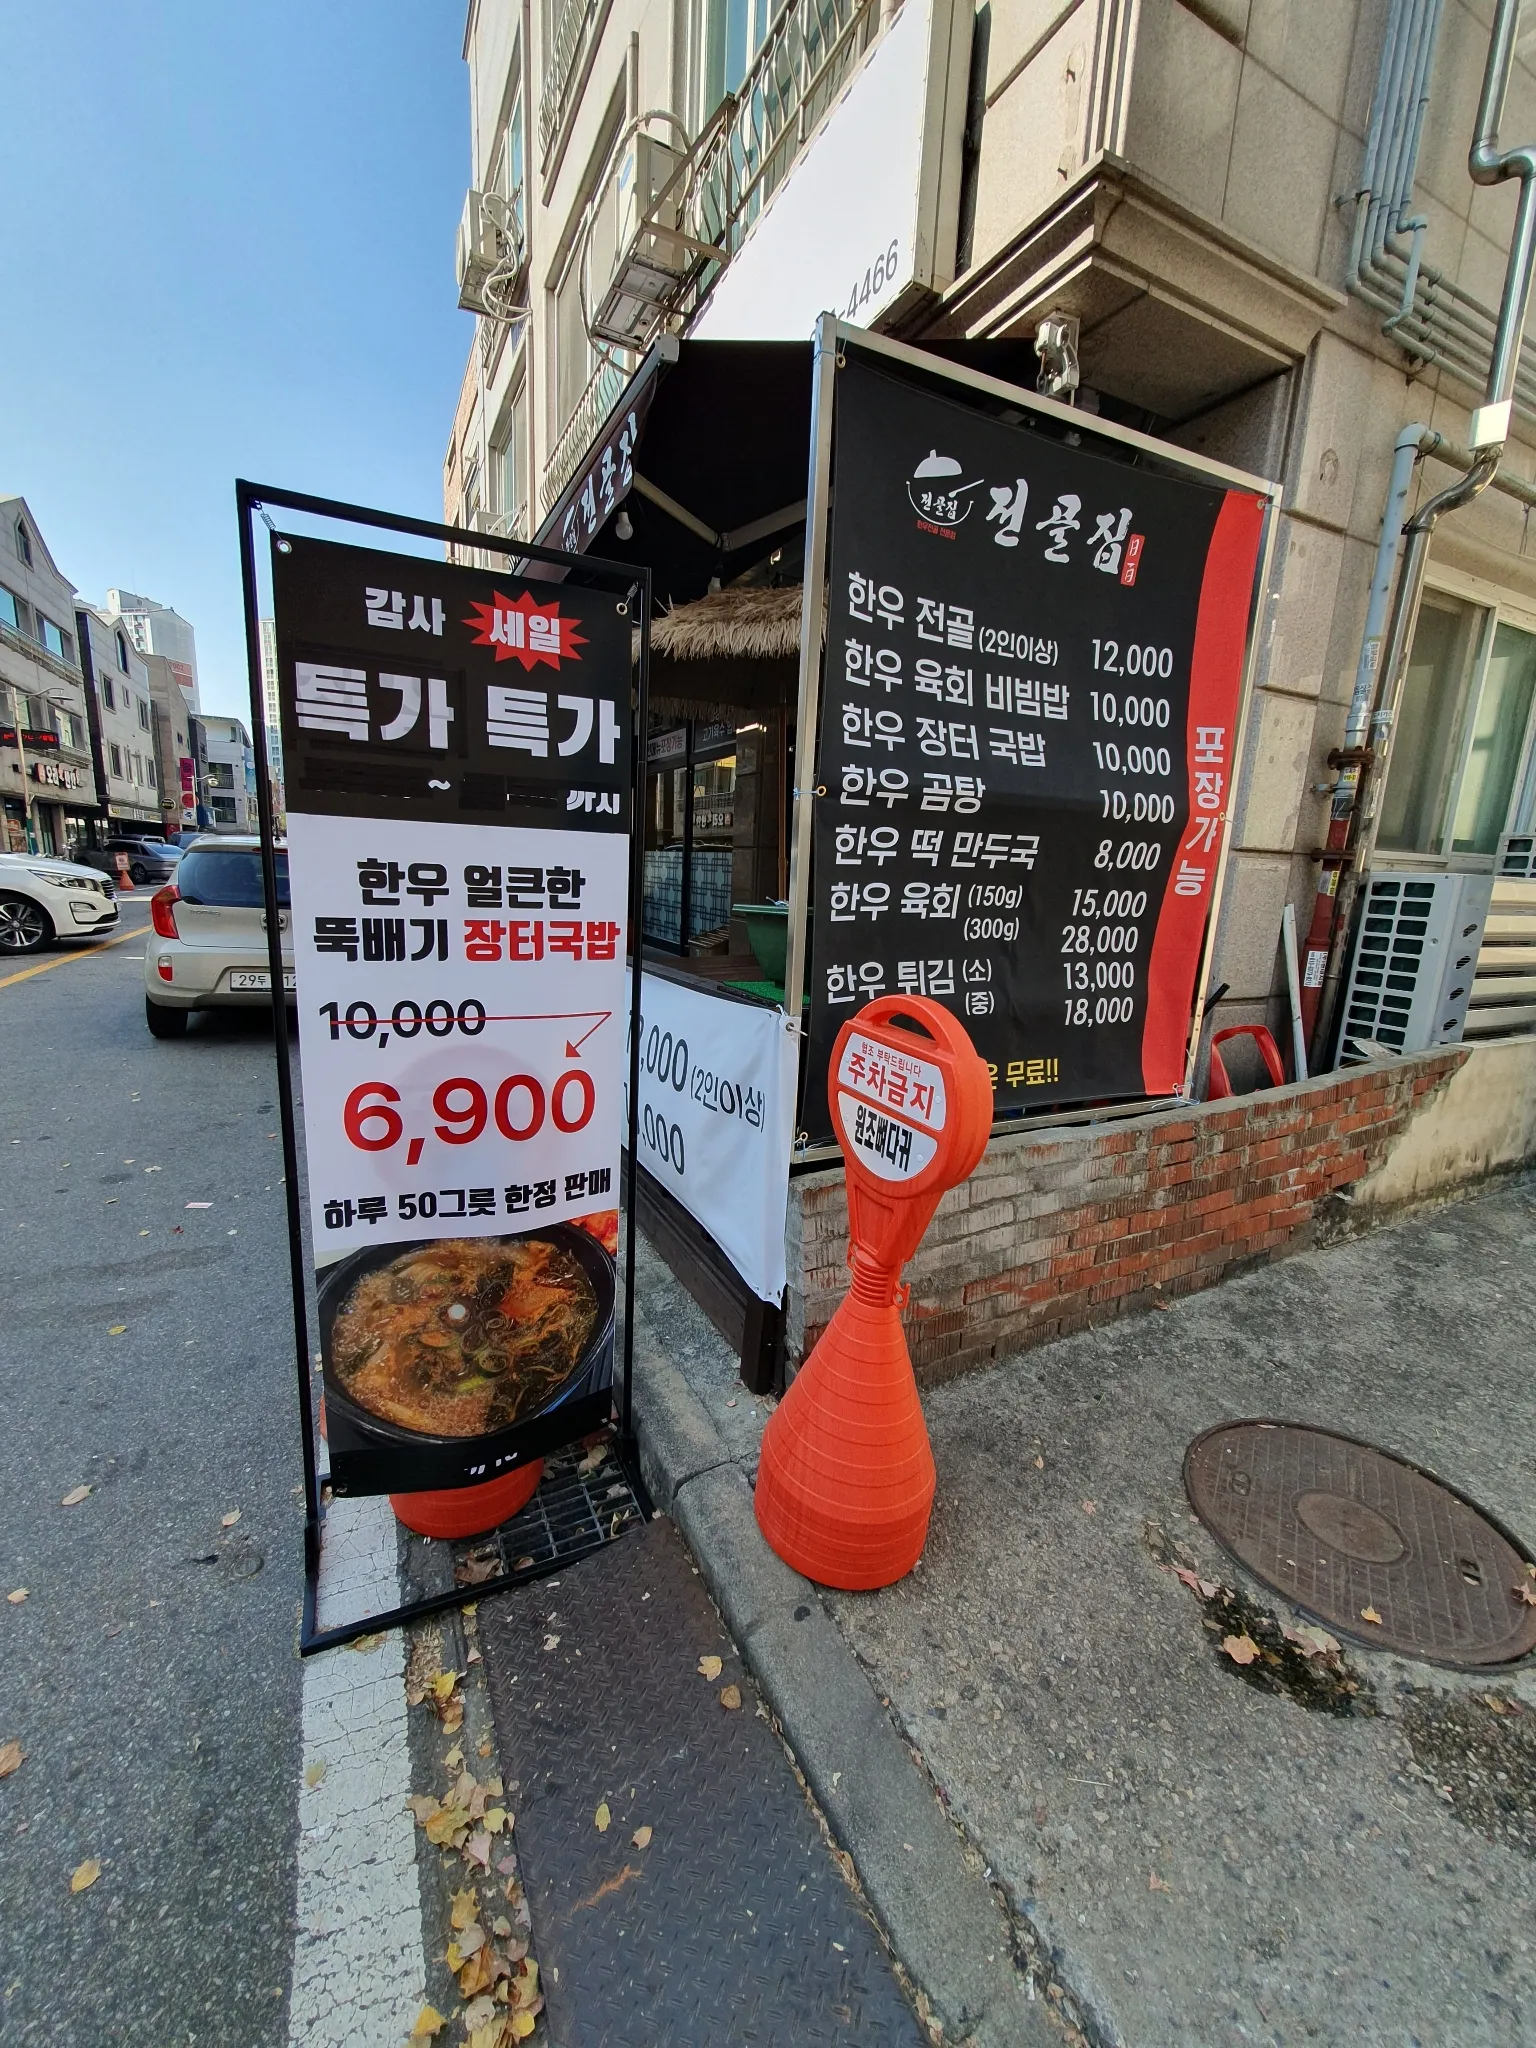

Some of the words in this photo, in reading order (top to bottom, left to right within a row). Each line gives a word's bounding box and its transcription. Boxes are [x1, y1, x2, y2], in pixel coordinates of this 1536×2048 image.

[832, 238, 899, 319] -4466
[921, 491, 958, 520] 전골집
[986, 478, 1132, 575] 전골집
[365, 587, 446, 635] 감사
[489, 609, 561, 654] 세일
[848, 571, 905, 630] 한우
[916, 597, 975, 651] 전골
[978, 626, 1059, 666] (2인이상)
[1092, 639, 1173, 678] 12,000
[845, 638, 903, 692] 한우
[915, 658, 974, 706] 육회
[985, 672, 1070, 720] 비빔밥
[1090, 691, 1170, 728] 10,000
[295, 662, 454, 749] 특가
[486, 685, 621, 764] 특가
[842, 702, 906, 752] 한우
[916, 717, 980, 761] 장터
[988, 727, 1046, 768] 국밥
[1093, 741, 1171, 777] 10,000
[840, 763, 909, 809] 한우
[920, 773, 986, 814] 곰탕
[1100, 790, 1175, 824] 10,000
[1174, 726, 1225, 897] 포장가능
[835, 824, 899, 866] 한우
[910, 829, 943, 866] 떡
[950, 831, 1039, 870] 만두국
[1094, 840, 1161, 871] 8,000
[357, 858, 450, 906] 한우
[463, 865, 586, 910] 얼큰한
[830, 881, 890, 922] 한우
[900, 882, 961, 920] 육회
[967, 884, 1023, 909] (150g)
[1072, 888, 1147, 917] 15,000
[314, 917, 449, 962] 뚝배기
[463, 919, 620, 962] 장터국밥
[964, 917, 1020, 942] (300g)
[1061, 925, 1138, 954] 28,000
[239, 974, 267, 987] 29두
[826, 961, 885, 1004] 한우
[897, 958, 956, 996] 튀김
[962, 958, 992, 984] (소)
[1063, 962, 1134, 991] 13,000
[319, 999, 486, 1048] 10,000
[965, 991, 995, 1016] (중)
[1064, 997, 1133, 1027] 18,000
[861, 1041, 875, 1057] 협조
[876, 1049, 921, 1078] 부탁드립니다
[1005, 1058, 1059, 1088] 무료!!
[691, 1065, 766, 1132] (2인이상)
[848, 1052, 935, 1120] 주차금지
[342, 1068, 597, 1166] 6,900
[854, 1104, 913, 1172] 원조뼈다귀
[324, 1196, 388, 1230] 하루
[398, 1188, 497, 1220] 50그릇
[505, 1180, 556, 1213] 한정
[564, 1168, 612, 1201] 판매
